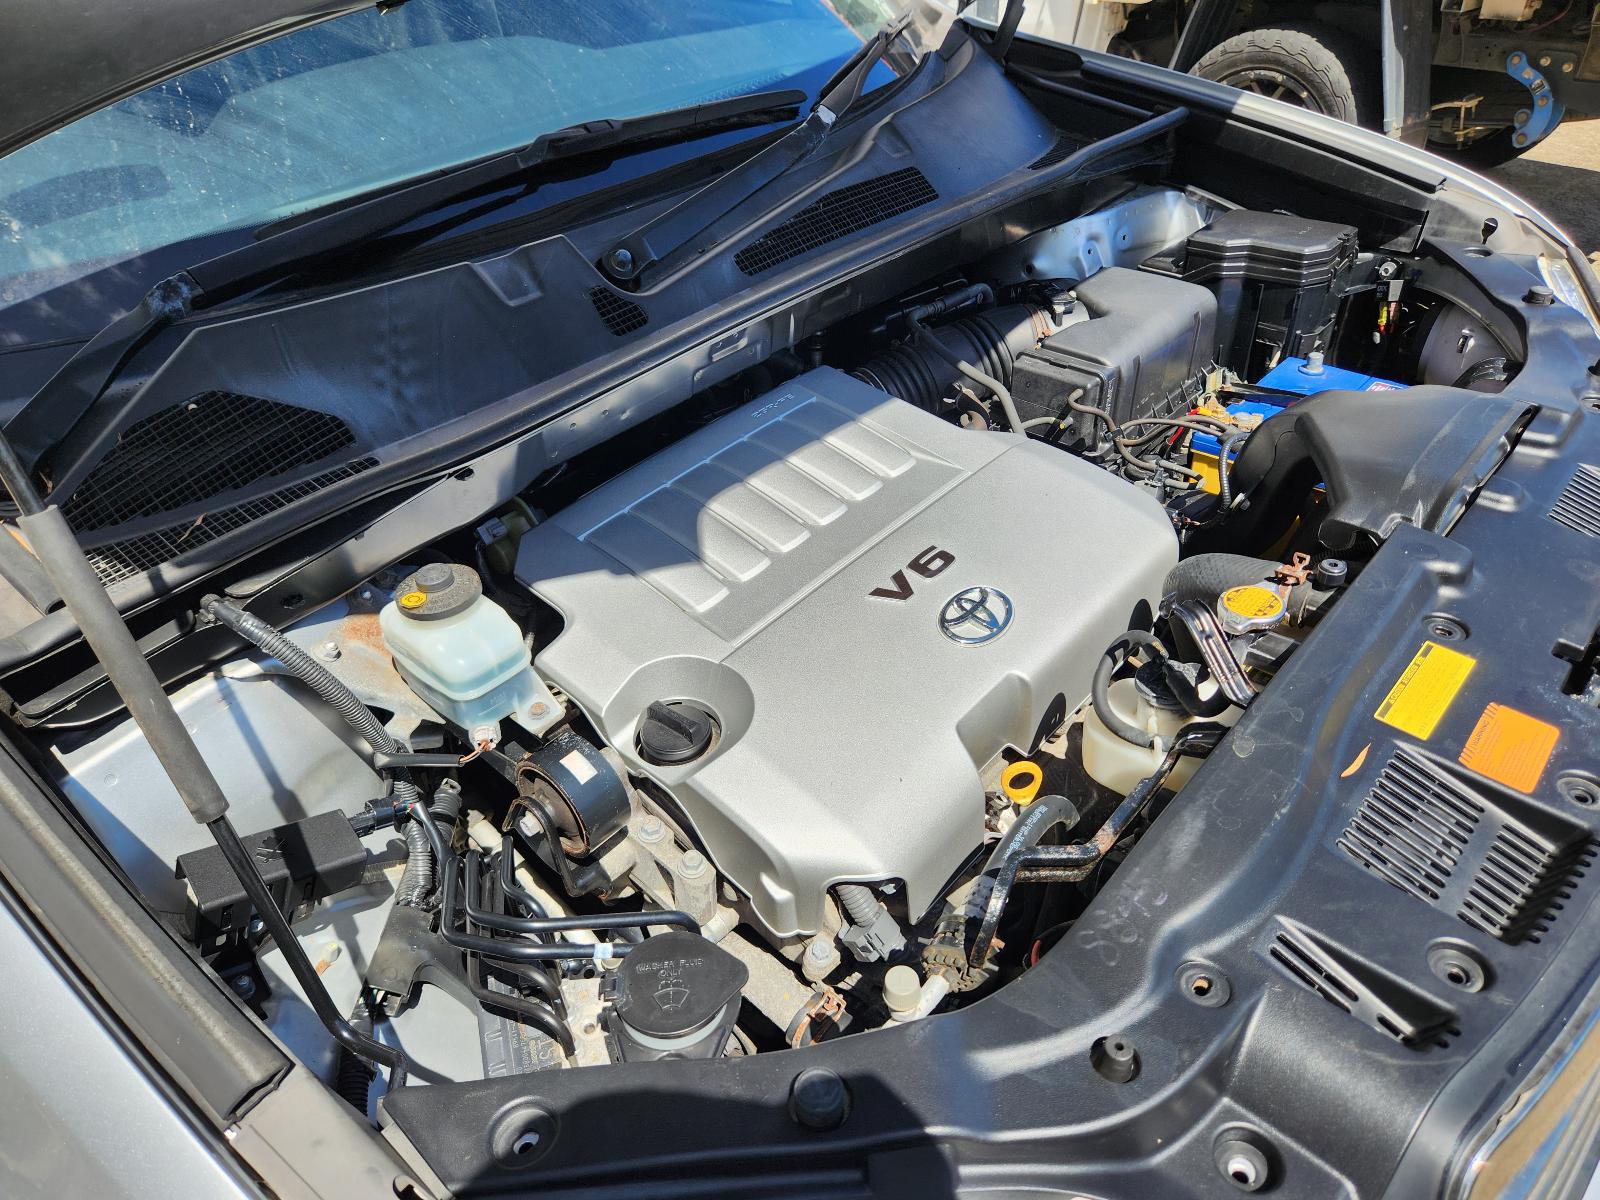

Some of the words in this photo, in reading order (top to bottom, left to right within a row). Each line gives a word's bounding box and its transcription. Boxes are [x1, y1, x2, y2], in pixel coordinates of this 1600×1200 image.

[868, 545, 956, 602] V6
[1473, 720, 1490, 746] WARNING
[636, 960, 675, 974] WASHER
[680, 958, 704, 967] FLUID
[659, 968, 681, 977] ONLY
